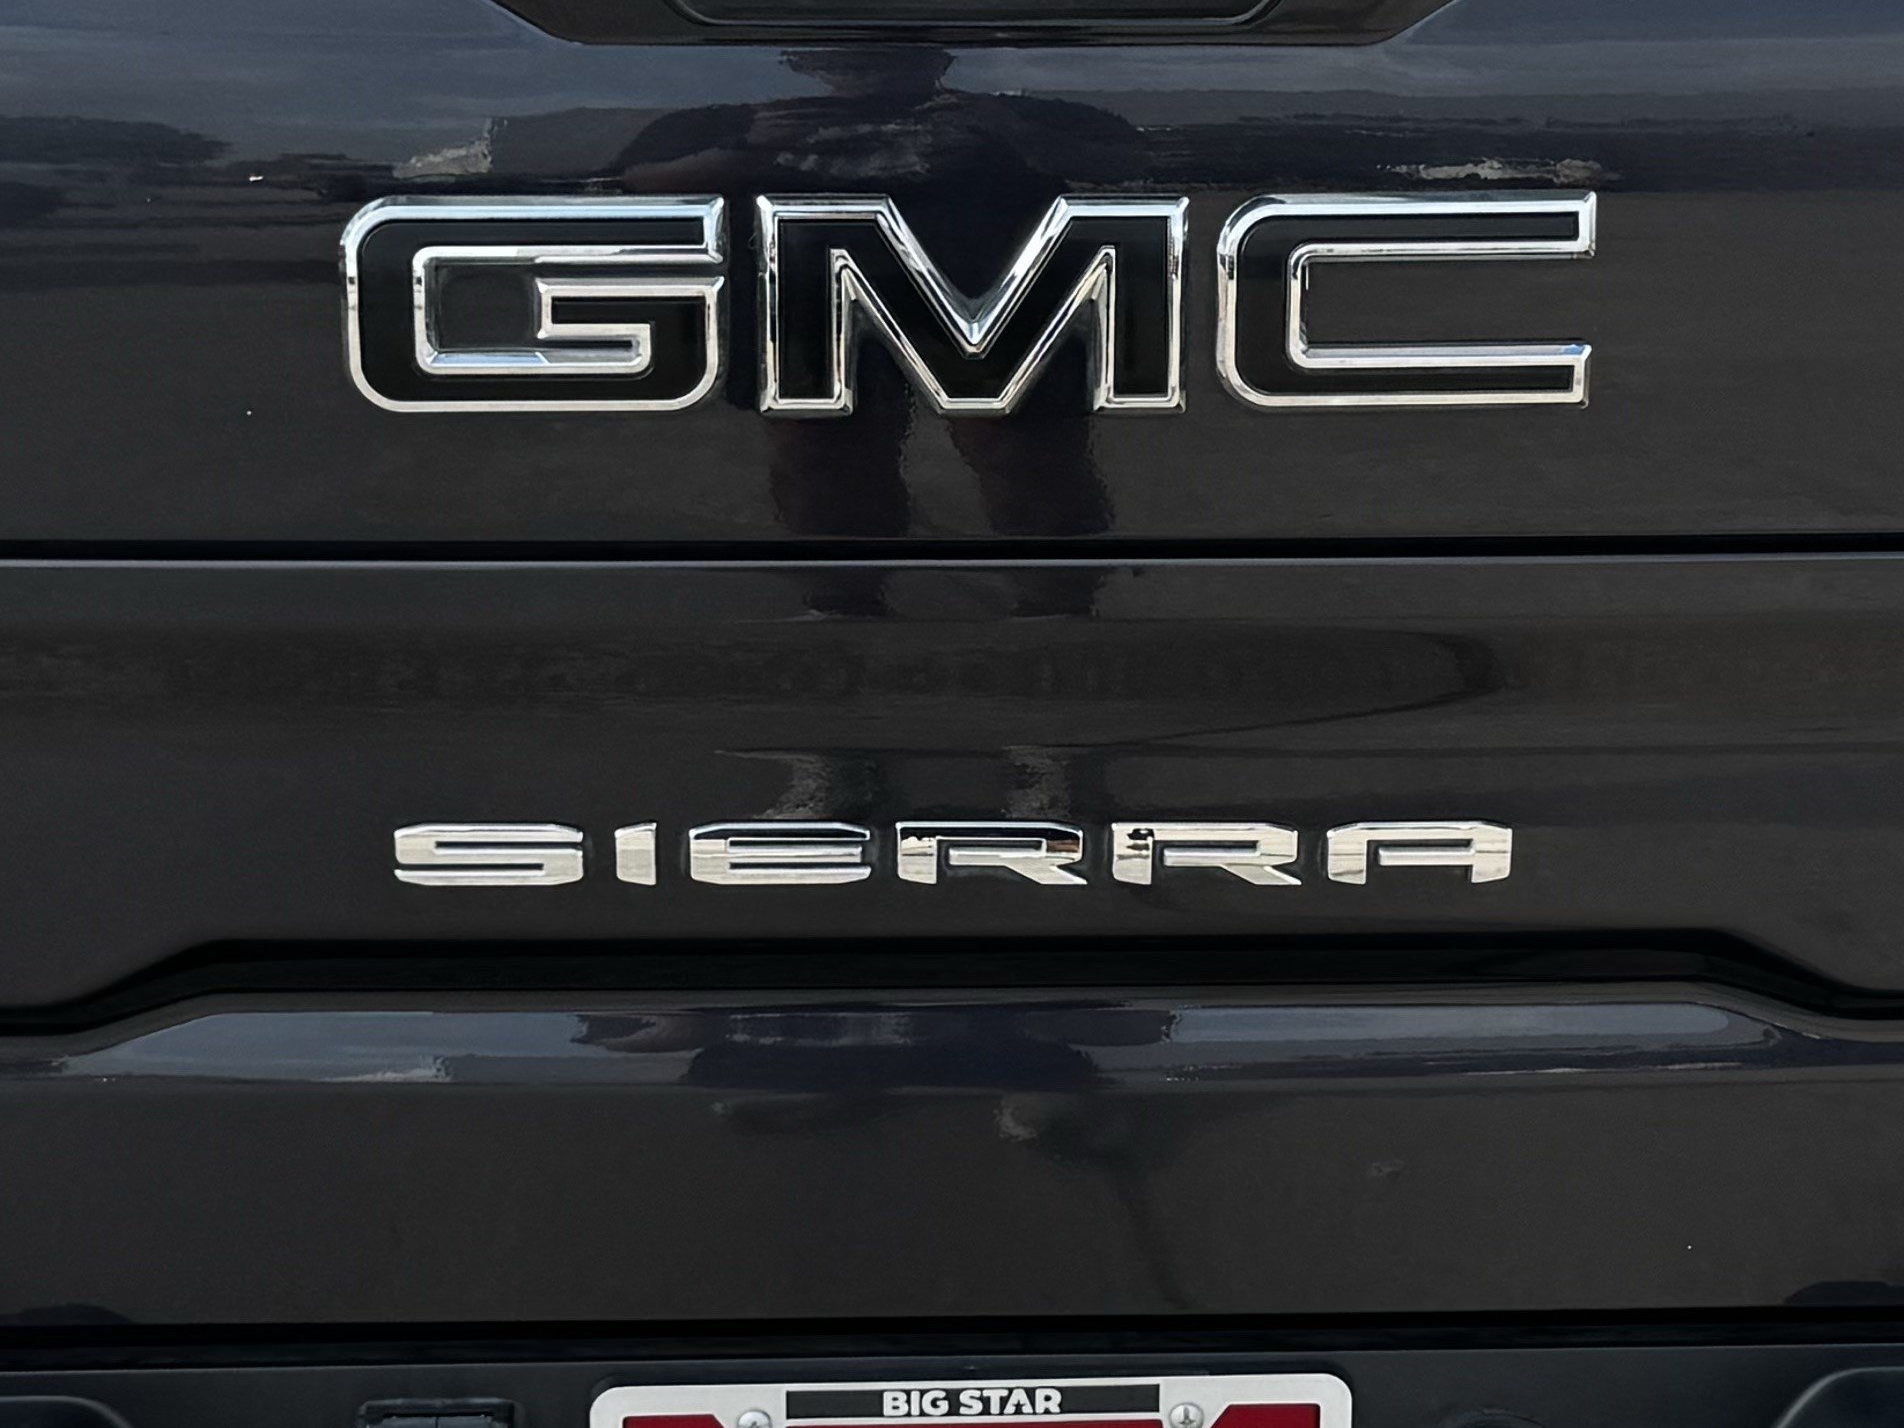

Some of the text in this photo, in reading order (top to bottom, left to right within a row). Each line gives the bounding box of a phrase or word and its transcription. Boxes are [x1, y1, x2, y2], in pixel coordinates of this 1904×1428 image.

[339, 194, 1597, 415] GMC
[392, 820, 1514, 886] SIERRA
[882, 1387, 1063, 1417] BIG STAR
